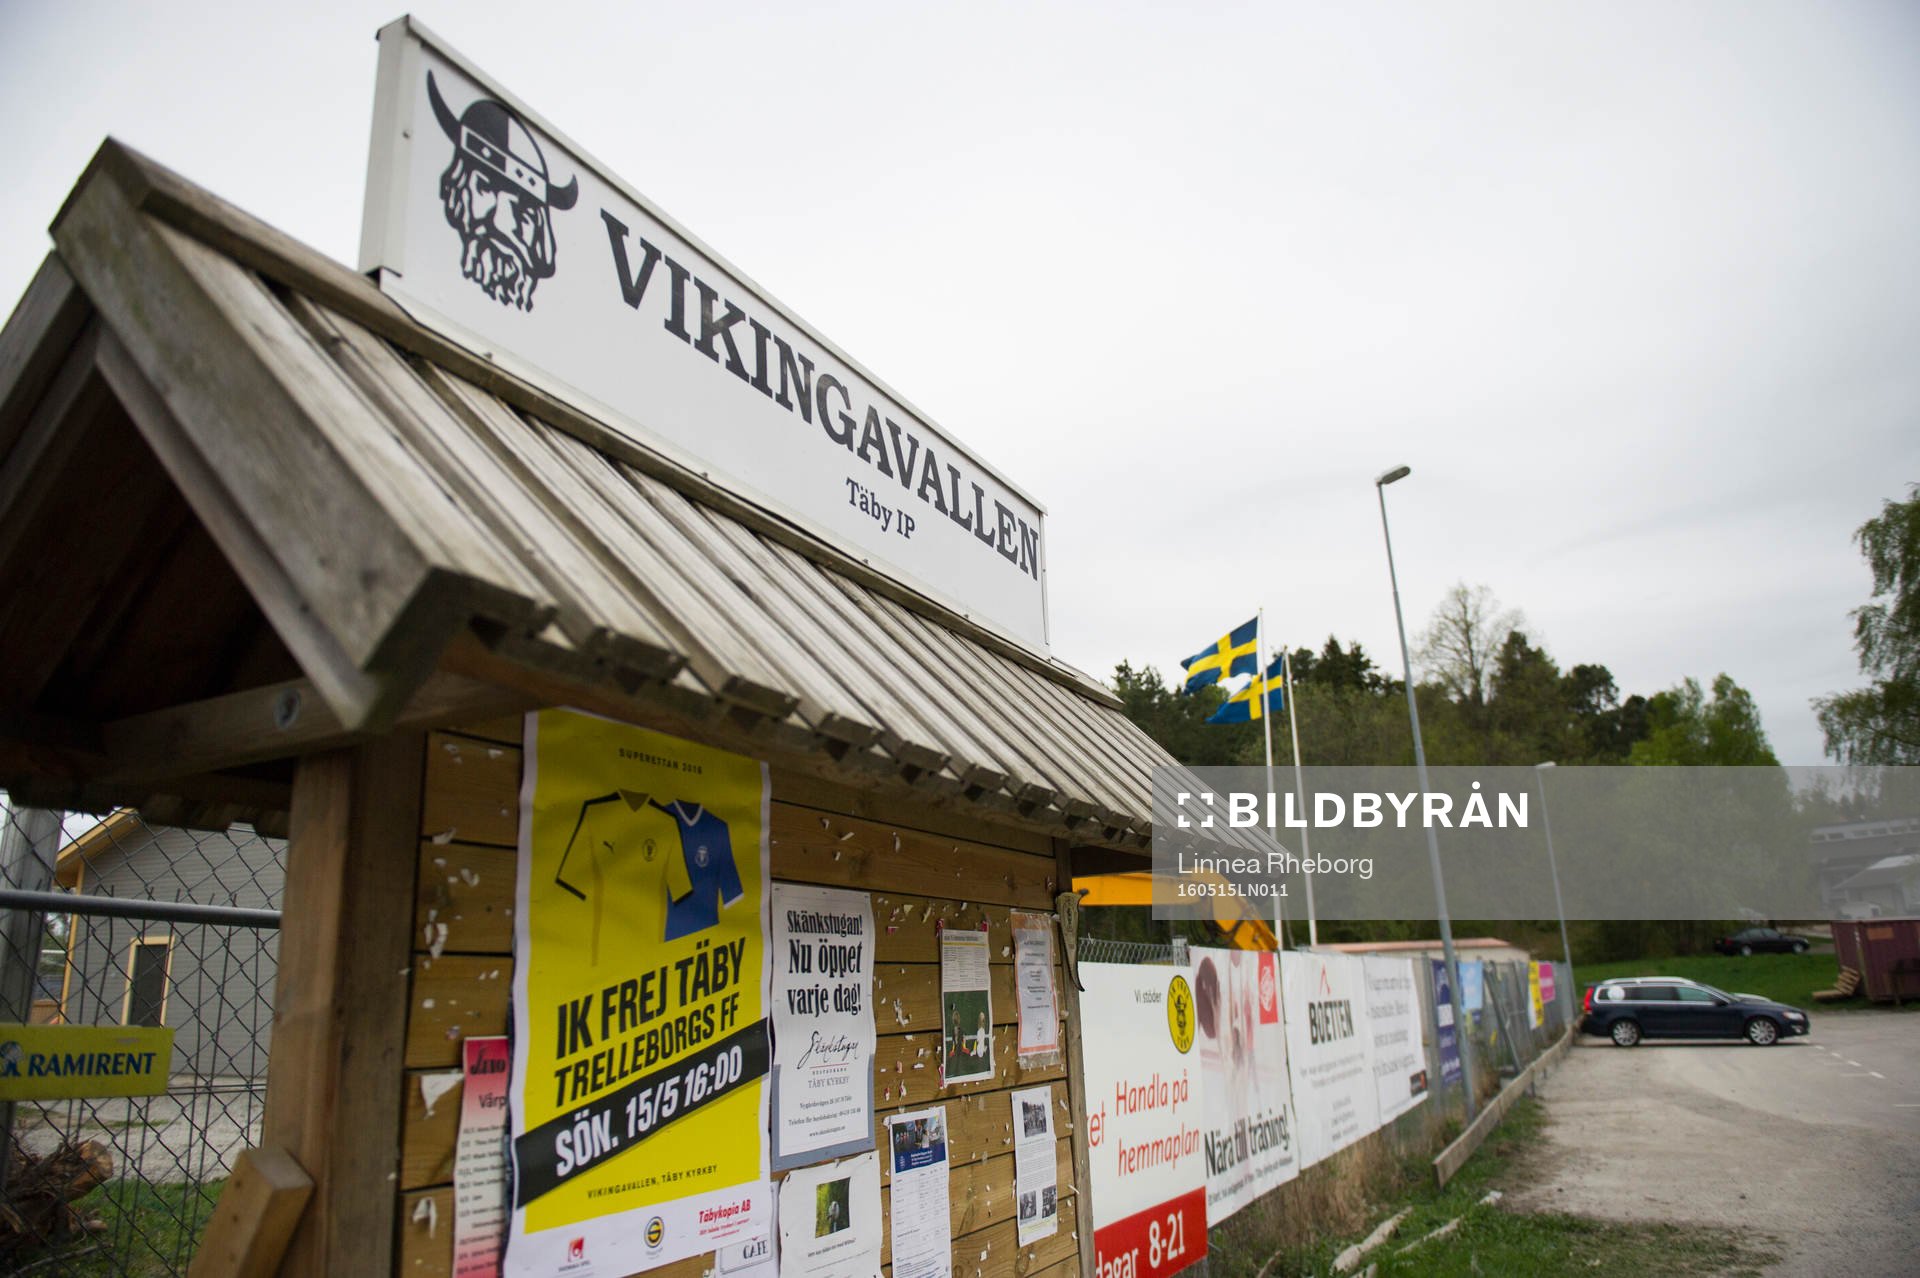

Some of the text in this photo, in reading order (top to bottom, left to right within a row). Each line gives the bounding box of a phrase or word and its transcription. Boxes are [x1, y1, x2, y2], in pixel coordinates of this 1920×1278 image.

[601, 208, 1039, 581] VIKINGAVALLEN
[846, 477, 915, 539] Täby IP
[618, 747, 678, 769] SUPERETTAN
[787, 910, 863, 938] Skänkstugan!
[789, 938, 863, 978] Nu öppet
[556, 937, 746, 1060] IK FREJ TÄBY
[787, 983, 861, 1018] varje dag!
[1308, 999, 1354, 1045] BOETTEN
[28, 1052, 157, 1077] RAMIRENT
[555, 992, 739, 1108] TRELLEBORGS FF
[555, 1045, 742, 1177] SÖN. 15/5 16:00
[1116, 1068, 1189, 1117] Handla på
[1087, 1101, 1106, 1148] et
[1204, 1130, 1234, 1180] Nära
[1234, 1117, 1248, 1164] till
[1248, 1103, 1290, 1153] träning!
[1118, 1122, 1200, 1177] hemmaplan
[587, 1164, 718, 1199] VIKINGAVALLEN, TÄBY KYRKBY
[699, 1198, 751, 1224] Täbykopia AB
[1149, 1208, 1185, 1270] 8-21
